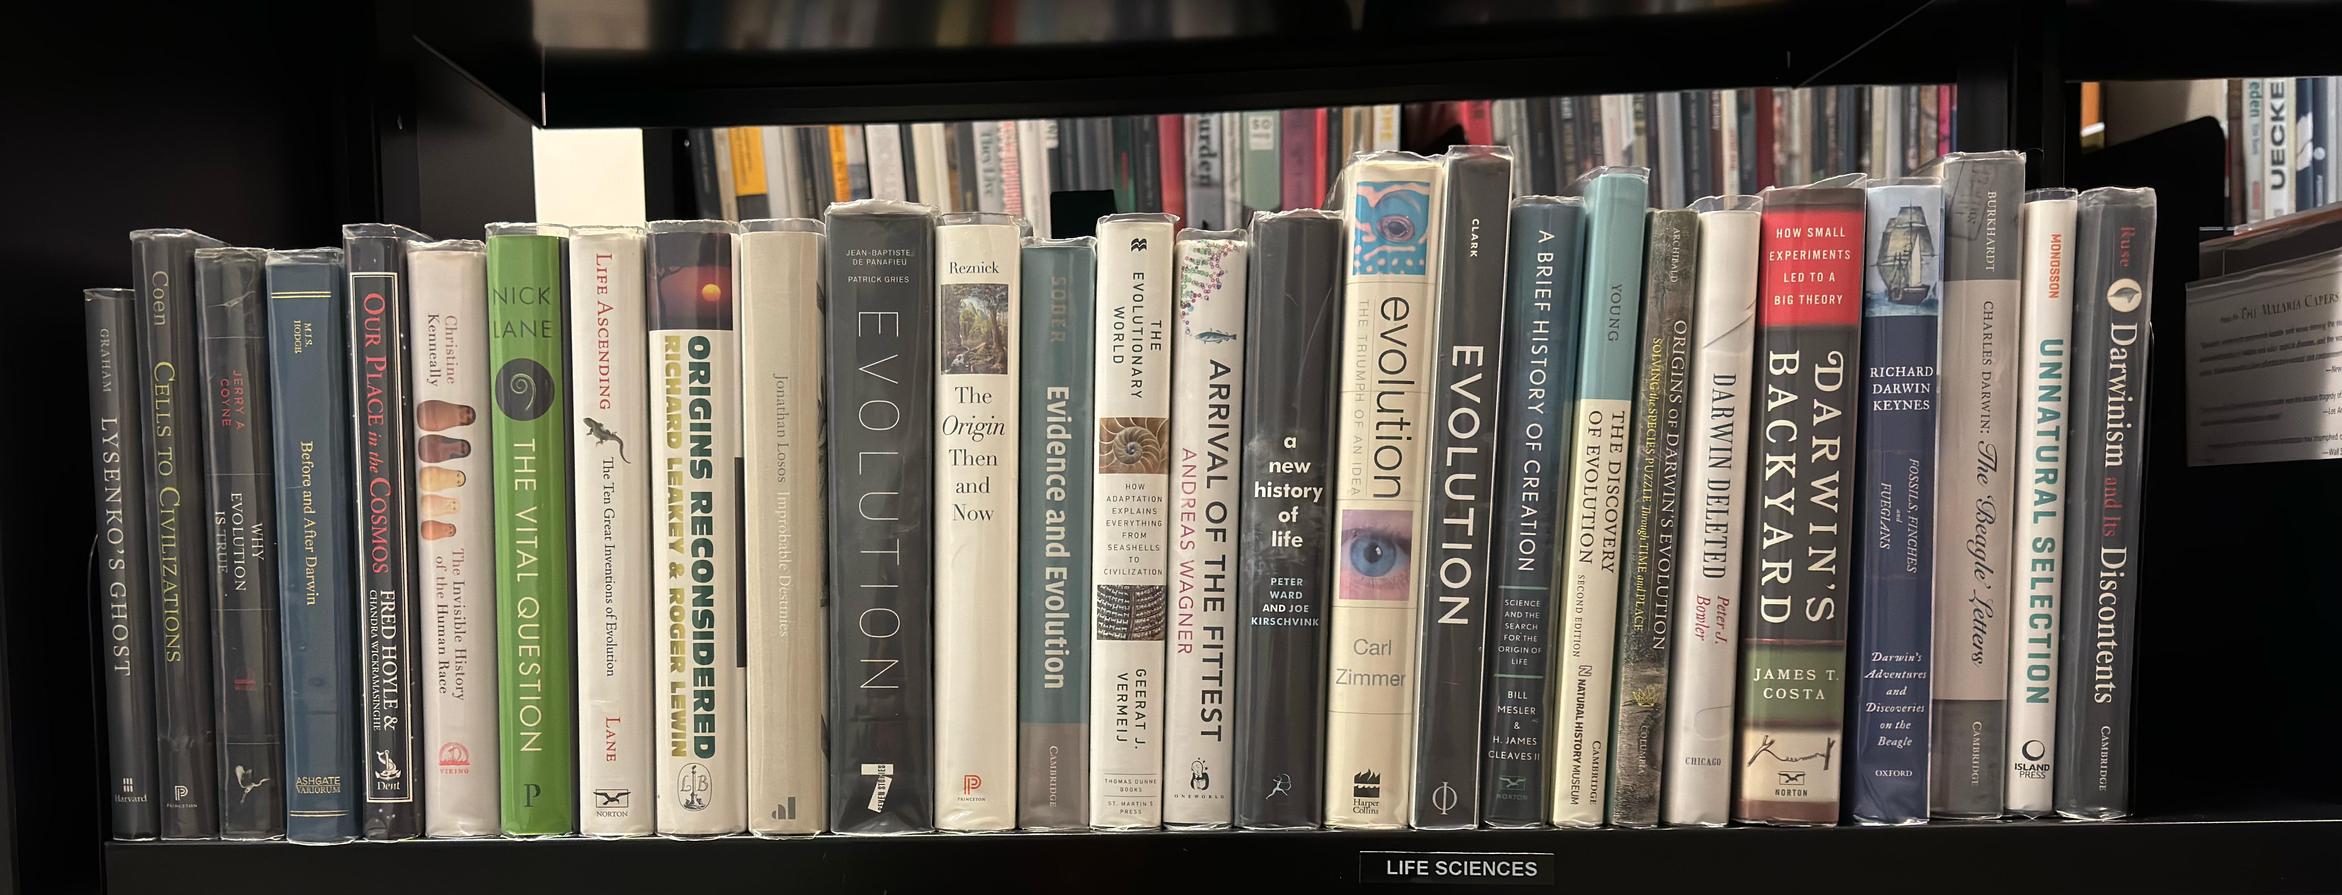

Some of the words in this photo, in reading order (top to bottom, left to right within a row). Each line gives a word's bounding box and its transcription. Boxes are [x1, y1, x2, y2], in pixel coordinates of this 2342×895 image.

[1196, 114, 1217, 187] urden
[1470, 218, 1479, 258] CLARK
[1776, 227, 1802, 239] HOW
[1807, 227, 1846, 239] SMALL
[1984, 191, 1997, 272] BURKHARDT
[2119, 226, 2136, 268] Ruse
[846, 249, 911, 257] JEAN-BAPTISTE
[949, 261, 999, 275] Reznick
[1670, 227, 1681, 283] ARCHIBALD
[1769, 249, 1851, 261] EXPERIMENTS
[2048, 233, 2062, 299] MONOSSON
[596, 253, 613, 295] LIFE
[848, 275, 882, 283] PATRICK
[884, 275, 910, 283] GRIES
[152, 270, 168, 327] Coen
[493, 287, 551, 305] NICK
[1608, 283, 1623, 342] YOUNG
[1774, 295, 1794, 305] BIG
[1799, 295, 1843, 305] THEORY
[493, 320, 552, 338] LANE
[1150, 320, 1162, 351] THE
[100, 328, 111, 393] GRAHAM
[427, 314, 441, 387] Kenneally
[445, 315, 458, 385] Christine
[597, 300, 614, 410] ASCENDING
[1669, 320, 1687, 403] ORIGINS
[1870, 366, 1933, 378] RICHARD
[1872, 383, 1931, 394] DARWIN
[220, 378, 231, 427] COYNE
[688, 335, 712, 480] ORIGINS
[773, 373, 789, 438] Jonathan
[954, 386, 992, 404] The
[1873, 400, 1930, 411] KEYNES
[942, 415, 1005, 442] Origin
[1206, 359, 1231, 489] ARRIVAL
[1587, 410, 1603, 438] OF
[1609, 410, 1625, 453] THE
[1667, 408, 1679, 428] OF
[1707, 373, 1737, 469] DARWIN
[2033, 339, 2064, 524] UNNATURAL
[948, 449, 998, 467] Then
[1284, 437, 1297, 449] a
[301, 441, 314, 486] Before
[513, 438, 536, 491] THE
[602, 458, 615, 480] The
[777, 443, 790, 483] Losos
[1269, 460, 1311, 473] new
[1659, 432, 1679, 528] DARWIN'S
[303, 490, 316, 514] and
[603, 482, 615, 505] Ten
[858, 311, 901, 689] EVOLUTION
[956, 476, 990, 494] and
[1254, 482, 1323, 503] history
[1438, 345, 1484, 625] EVOLUTION
[1760, 350, 1800, 623] BACKYARD
[1907, 458, 1919, 514] FOSSILS,
[214, 511, 226, 525] IS
[952, 503, 994, 522] Now
[1205, 502, 1228, 543] OF
[1579, 445, 1601, 565] EVOLUTION
[1601, 461, 1622, 574] DISCOVERY
[230, 493, 246, 592] EVOLUTION
[251, 522, 264, 561] WHY
[304, 518, 317, 553] After
[603, 508, 615, 541] Great
[775, 491, 790, 571] Improbable
[1271, 530, 1303, 548] life
[1702, 478, 1731, 579] DELETED
[216, 530, 228, 574] TRUE
[452, 548, 465, 576] The
[515, 506, 538, 583] VITAL
[1906, 516, 1919, 573] FINCHES
[305, 557, 319, 606] Darwin
[435, 556, 447, 571] of
[604, 544, 616, 604] Inventions
[1103, 568, 1163, 576] CIVILIZATION
[1270, 577, 1303, 586] PETER
[436, 576, 448, 599] the
[1203, 554, 1226, 613] THE
[1270, 591, 1303, 600] WARD
[1575, 573, 1586, 611] SECOND
[1652, 534, 1672, 650] EVOLUTION
[452, 581, 466, 642] Invisible
[605, 607, 618, 620] of
[779, 575, 791, 638] Destinies
[1262, 604, 1287, 613] AND
[1288, 604, 1309, 613] JOE
[1504, 599, 1541, 607] SCIENCE
[1504, 611, 1523, 619] AND
[1525, 611, 1540, 619] THE
[2026, 536, 2056, 704] SELECTION
[437, 603, 449, 655] Human
[690, 491, 717, 759] RECONSIDERED
[1251, 617, 1319, 626] KIRSCHVINK
[1503, 634, 1519, 642] FOR
[1522, 634, 1538, 642] THE
[1504, 623, 1538, 631] SEARCH
[1572, 615, 1583, 656] EDITION
[605, 622, 618, 677] Evolution
[1353, 639, 1392, 656] Carl
[1511, 657, 1528, 666] LIFE
[438, 660, 450, 694] Race
[451, 649, 467, 701] History
[517, 597, 543, 753] QUESTION
[1200, 626, 1225, 742] FITTEST
[1336, 669, 1406, 687] Zimmer
[1864, 669, 1927, 680] Adventures
[1886, 686, 1906, 697] and
[1116, 673, 1128, 742] VERMEIJ
[1497, 705, 1536, 715] MESLER
[1507, 690, 1527, 699] BILL
[1575, 679, 1586, 720] NATURAL
[1763, 688, 1825, 700] COSTA
[1865, 702, 1925, 714] Discoveries
[605, 716, 620, 762] LANE
[1573, 722, 1584, 763] HISTORY
[1638, 725, 1648, 774] COLUMBIA
[1877, 736, 1913, 750] Beagle
[1971, 721, 1983, 785] CAMBRIDGE
[1049, 745, 1059, 807] CAMBRIDGE
[1685, 757, 1722, 766] CHICAGO
[2014, 762, 2050, 771] ISLAND
[2019, 771, 2046, 779] PRESS
[2099, 726, 2111, 792] CAMBRIDGE
[296, 777, 340, 785] ASHGATE
[296, 786, 341, 794] VARIORUM
[377, 781, 401, 791] Dent
[1570, 765, 1581, 805] MUSEUM
[1775, 789, 1808, 797] NORTON
[1353, 799, 1380, 809] Harper
[1353, 806, 1379, 815] Collins
[1387, 860, 1429, 875] LIFE
[1435, 859, 1538, 877] SCIENCES
